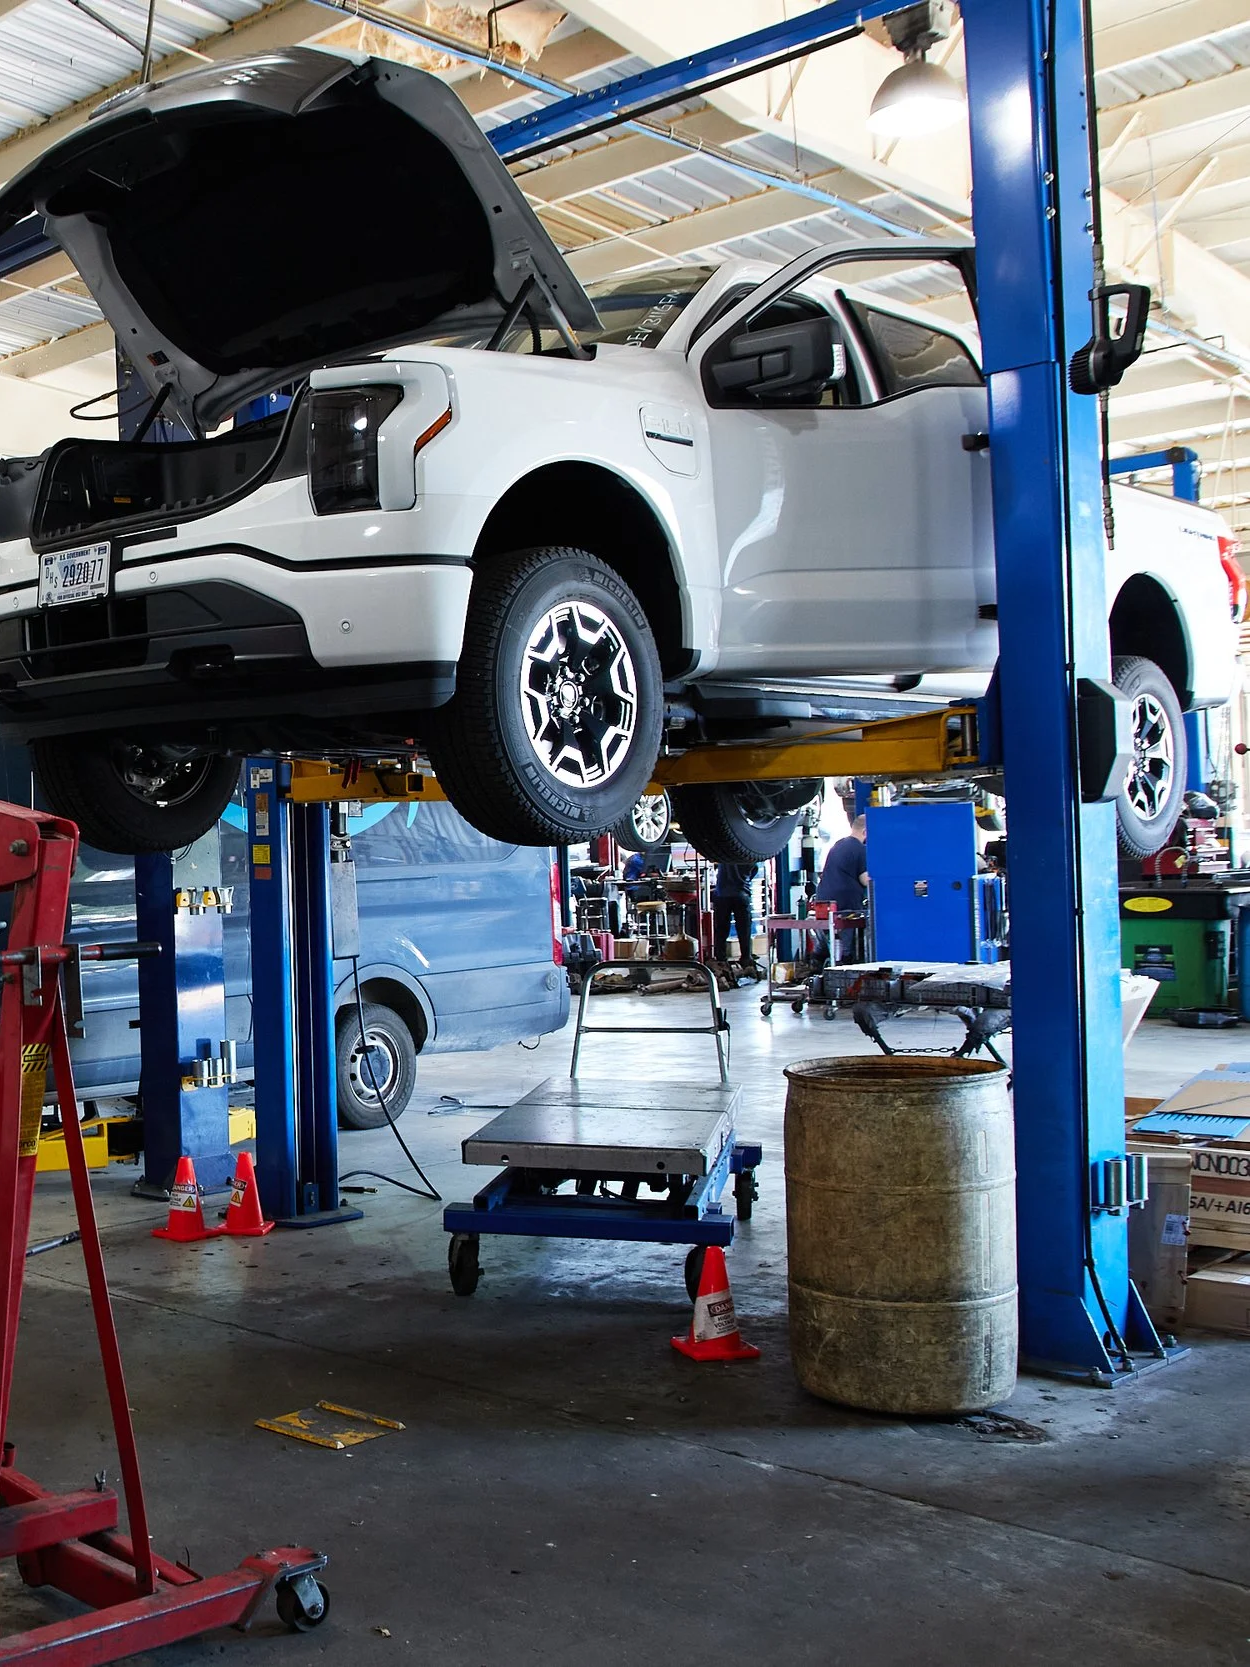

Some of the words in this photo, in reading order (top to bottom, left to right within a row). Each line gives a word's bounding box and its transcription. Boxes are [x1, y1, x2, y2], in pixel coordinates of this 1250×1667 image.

[62, 558, 104, 588] 292077
[67, 549, 91, 560] GOVERNMENT
[592, 571, 645, 627] MICHELIN
[525, 765, 581, 819] MICHELIN
